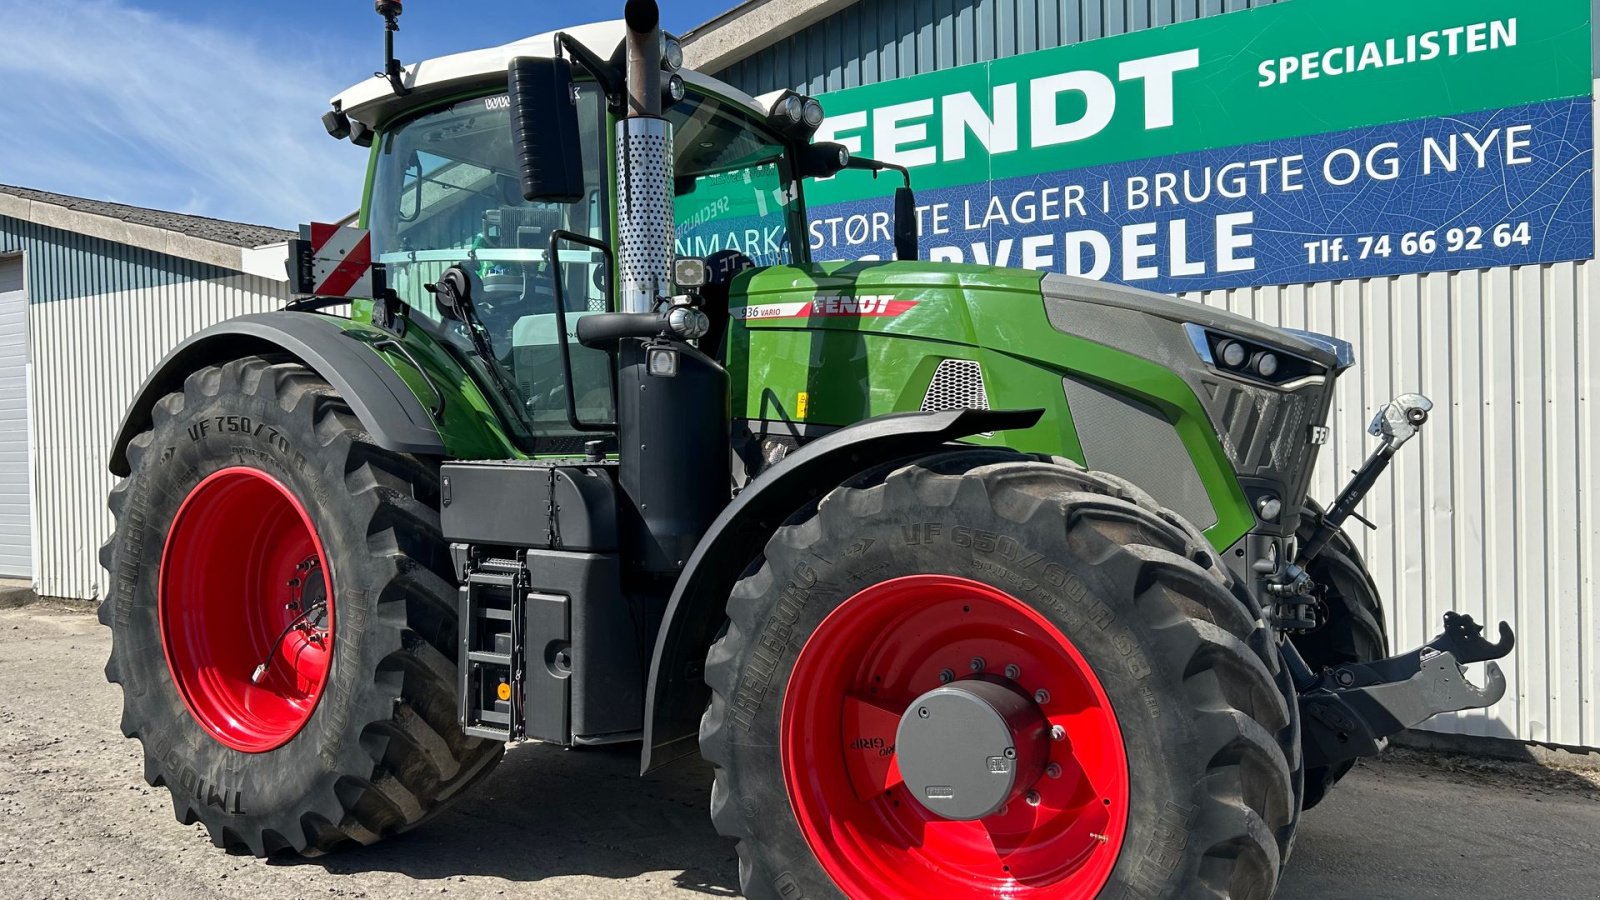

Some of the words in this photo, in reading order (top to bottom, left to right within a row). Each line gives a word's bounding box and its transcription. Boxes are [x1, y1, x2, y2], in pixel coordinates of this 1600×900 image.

[1258, 18, 1517, 87] SPECIALISTEN
[813, 48, 1199, 182] FENDT
[809, 203, 949, 250] STØRTE
[964, 185, 1087, 230] LAGER
[1102, 181, 1109, 213] I
[1127, 155, 1304, 210] BRUGTE
[1323, 142, 1399, 186] OG
[1423, 124, 1532, 175] NYE
[1304, 240, 1349, 264] Tlf.
[1357, 235, 1392, 259] 74
[1400, 231, 1436, 255] 66
[1446, 226, 1483, 252] 92
[1493, 222, 1531, 247] 64
[741, 307, 759, 318] 936
[760, 308, 780, 317] VARIO
[812, 294, 896, 314] FENDT
[187, 419, 210, 442] VF
[726, 560, 818, 733] TRELLEBORG
